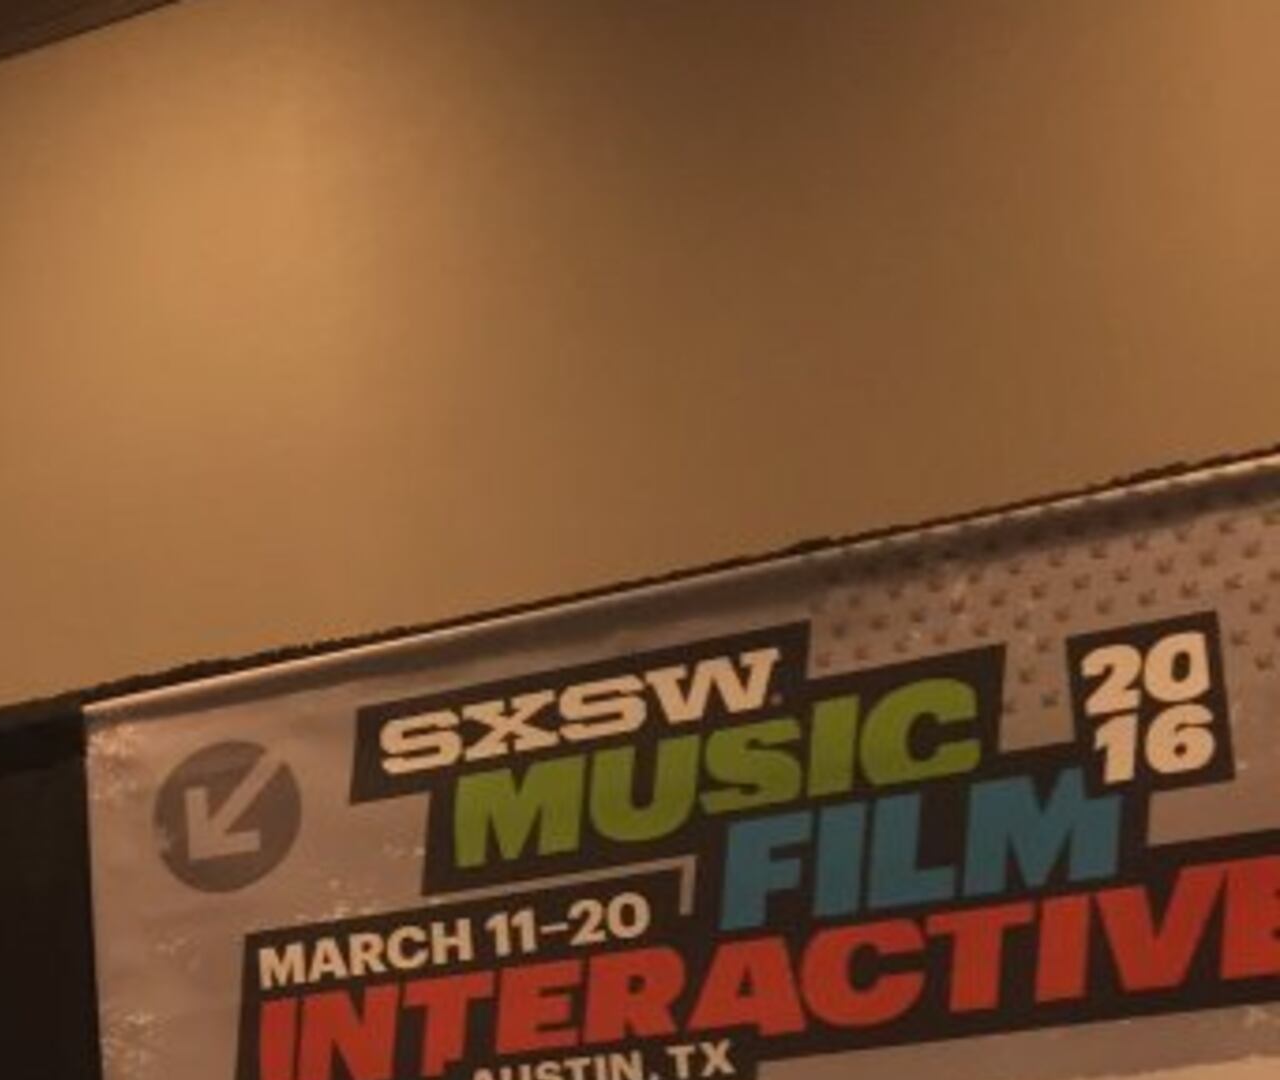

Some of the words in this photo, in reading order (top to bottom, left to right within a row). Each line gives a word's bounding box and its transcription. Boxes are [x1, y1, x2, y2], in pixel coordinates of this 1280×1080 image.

[379, 648, 780, 775] SXSW
[1081, 632, 1210, 716] 20
[453, 677, 982, 868] MUSIC
[1095, 704, 1216, 784] 16
[719, 767, 1121, 931] FILM
[258, 914, 472, 990] MARCH
[668, 1040, 736, 1080] TX
